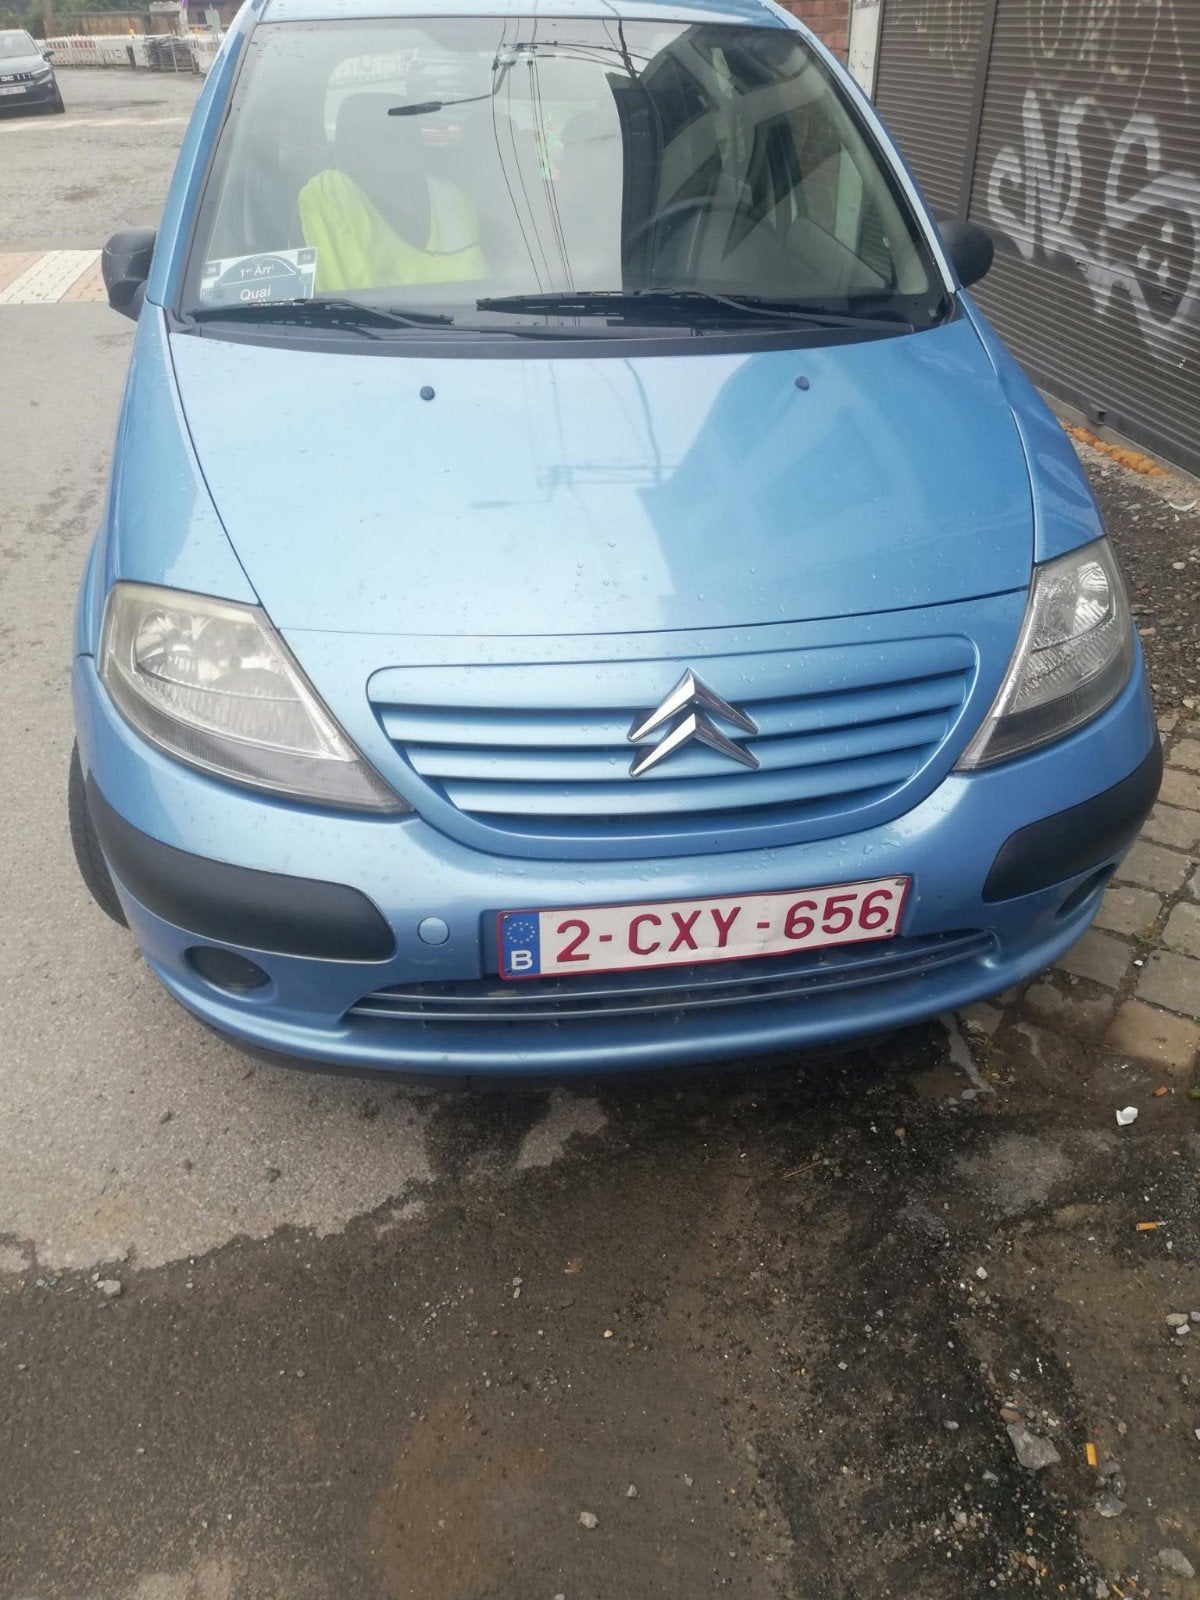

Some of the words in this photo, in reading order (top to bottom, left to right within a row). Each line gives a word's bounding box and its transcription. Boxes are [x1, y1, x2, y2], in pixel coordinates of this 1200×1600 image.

[240, 285, 271, 301] Quai
[511, 949, 533, 971] B
[556, 889, 894, 963] 2-CXY-656
